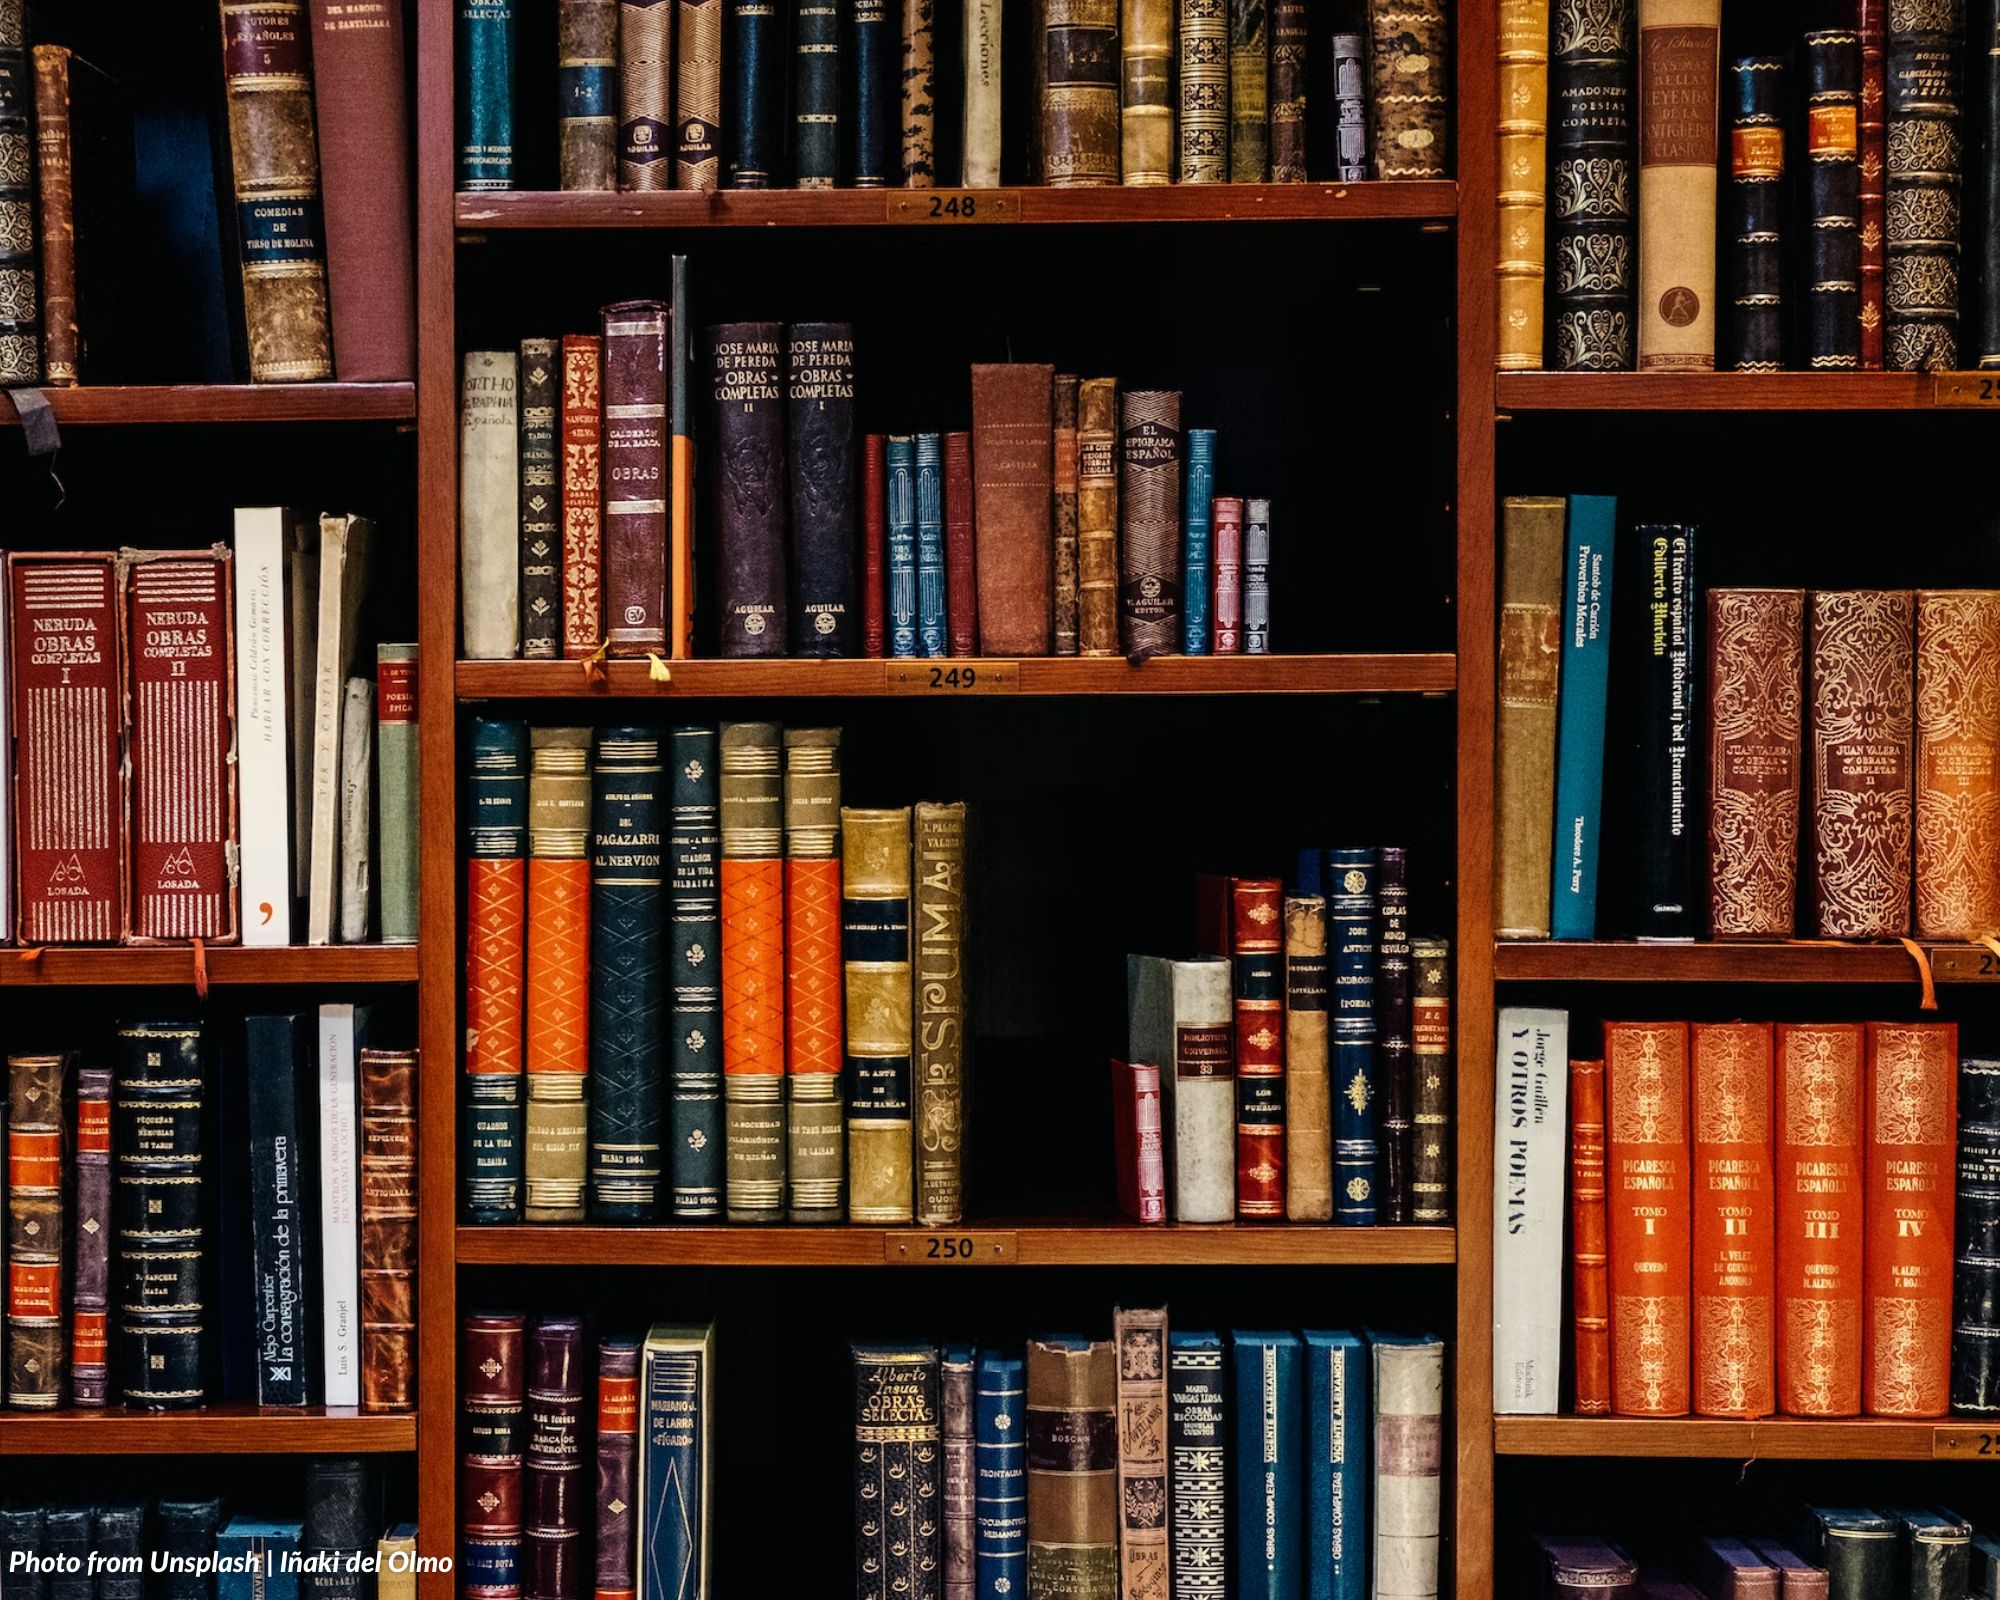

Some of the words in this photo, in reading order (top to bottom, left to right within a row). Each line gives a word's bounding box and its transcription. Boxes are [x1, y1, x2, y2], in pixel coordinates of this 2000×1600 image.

[463, 10, 511, 19] SELECTAS
[254, 207, 304, 217] COMEDIAS
[928, 197, 976, 217] 248
[272, 222, 287, 232] DE
[714, 342, 743, 355] JOSE
[745, 342, 779, 354] MARIA
[790, 341, 818, 353] JOSE
[821, 340, 853, 352] MARIA
[717, 357, 730, 368] DE
[734, 355, 776, 367] PEREDA
[793, 354, 805, 366] DE
[809, 354, 851, 365] PEREDA
[725, 371, 767, 385] OBRAS
[800, 369, 842, 383] OBRAS
[715, 386, 779, 400] COMPLETAS
[790, 385, 854, 398] COMPLETAS
[1143, 425, 1157, 435] EL
[1126, 438, 1175, 448] EPIGRAMA
[1126, 447, 1174, 459] ESPAÑOL
[612, 467, 658, 480] OBRAS
[1576, 545, 1590, 603] Proverbios
[1590, 554, 1602, 588] Santob
[1590, 590, 1601, 600] de
[735, 604, 774, 614] AGUILAR
[805, 603, 845, 613] AGUILAR
[33, 618, 97, 632] NERUDA
[146, 612, 208, 625] NERUDA
[1588, 602, 1600, 639] Carrión
[1670, 598, 1685, 646] español
[1575, 604, 1588, 648] Morales
[33, 636, 95, 652] OBRAS
[146, 629, 207, 646] OBRAS
[31, 652, 101, 664] COMPLETAS
[144, 645, 212, 658] COMPLETAS
[61, 667, 71, 683] I
[262, 659, 271, 681] CON
[929, 668, 976, 688] 249
[1727, 745, 1754, 755] JUAN
[1756, 745, 1791, 756] VALERA
[1836, 745, 1863, 756] JUAN
[1865, 745, 1900, 755] VALERA
[1929, 745, 1956, 755] JUAN
[1958, 745, 1998, 756] VALERA
[1747, 757, 1778, 765] OBRAS
[1856, 757, 1887, 765] OBRAS
[1950, 757, 1981, 765] OBRAS
[1732, 765, 1788, 774] COMPLETAS
[1842, 765, 1896, 774] COMPLETAS
[1935, 765, 1991, 774] COMPLETAS
[596, 834, 659, 845] PAGAZARRI
[1573, 816, 1585, 855] Theodore
[595, 855, 607, 866] AL
[608, 855, 660, 867] NERVION
[1572, 856, 1583, 867] A.
[157, 879, 200, 889] LOSADA
[1570, 869, 1583, 893] Perry
[48, 886, 89, 896] LOSADA
[1382, 906, 1407, 916] COPLAS
[1389, 918, 1399, 928] DE
[1511, 1028, 1530, 1041] Y
[1534, 1029, 1550, 1068] Jorge
[1199, 1064, 1213, 1075] 33
[1256, 1089, 1272, 1097] LOS
[1510, 1050, 1529, 1128] OTROS
[1534, 1073, 1549, 1124] Guillén
[1245, 1104, 1282, 1112] PUEBLOS
[272, 1136, 293, 1204] primavera
[1623, 1160, 1676, 1173] PICARESCA
[1709, 1160, 1760, 1173] PICARESCA
[1796, 1161, 1849, 1176] PICARESCA
[1508, 1139, 1528, 1235] POEMAS
[1624, 1176, 1674, 1190] ESPAÑOLA
[1710, 1176, 1759, 1190] ESPAÑOLA
[1797, 1178, 1847, 1192] ESPAÑOLA
[1887, 1177, 1936, 1192] ESPAÑOLA
[272, 1208, 288, 1219] la
[1632, 1207, 1667, 1217] TOMO
[1718, 1207, 1752, 1217] TOMO
[1804, 1210, 1840, 1221] TOMO
[1894, 1208, 1928, 1219] TOMO
[1645, 1219, 1655, 1235] I
[1725, 1219, 1747, 1235] II
[1804, 1222, 1840, 1239] III
[1898, 1220, 1926, 1237] IV
[273, 1225, 289, 1246] de
[927, 1238, 974, 1258] 250
[1633, 1261, 1668, 1273] QUEVEDO
[1804, 1264, 1840, 1275] QUEVEDO
[261, 1273, 278, 1331] Carpentier
[275, 1250, 297, 1343] consagración
[337, 1300, 348, 1336] Granjel
[263, 1335, 279, 1362] Alejo
[277, 1347, 293, 1362] La
[338, 1356, 347, 1375] Luis
[869, 1366, 926, 1383] Alberto
[875, 1381, 919, 1395] Insua
[1185, 1384, 1208, 1393] MARIO
[868, 1396, 925, 1407] OBRAS
[1173, 1393, 1199, 1403] VARGAS
[1201, 1393, 1223, 1403] LLOSA
[862, 1408, 934, 1422] SELECTAS
[1185, 1406, 1212, 1414] OBRAS
[653, 1418, 665, 1428] DE
[667, 1418, 694, 1429] LARRA
[1174, 1413, 1223, 1422] ESCOGIDAS
[1184, 1428, 1215, 1436] CUENTOS
[1265, 1420, 1275, 1463] VICENTE
[1332, 1419, 1342, 1463] VICENTE
[1265, 1472, 1275, 1526] COMPLETAS
[1332, 1472, 1342, 1526] COMPLETAS
[984, 1529, 1021, 1539] HUMANOS
[1265, 1527, 1275, 1560] OBRAS
[1332, 1527, 1342, 1560] OBRAS
